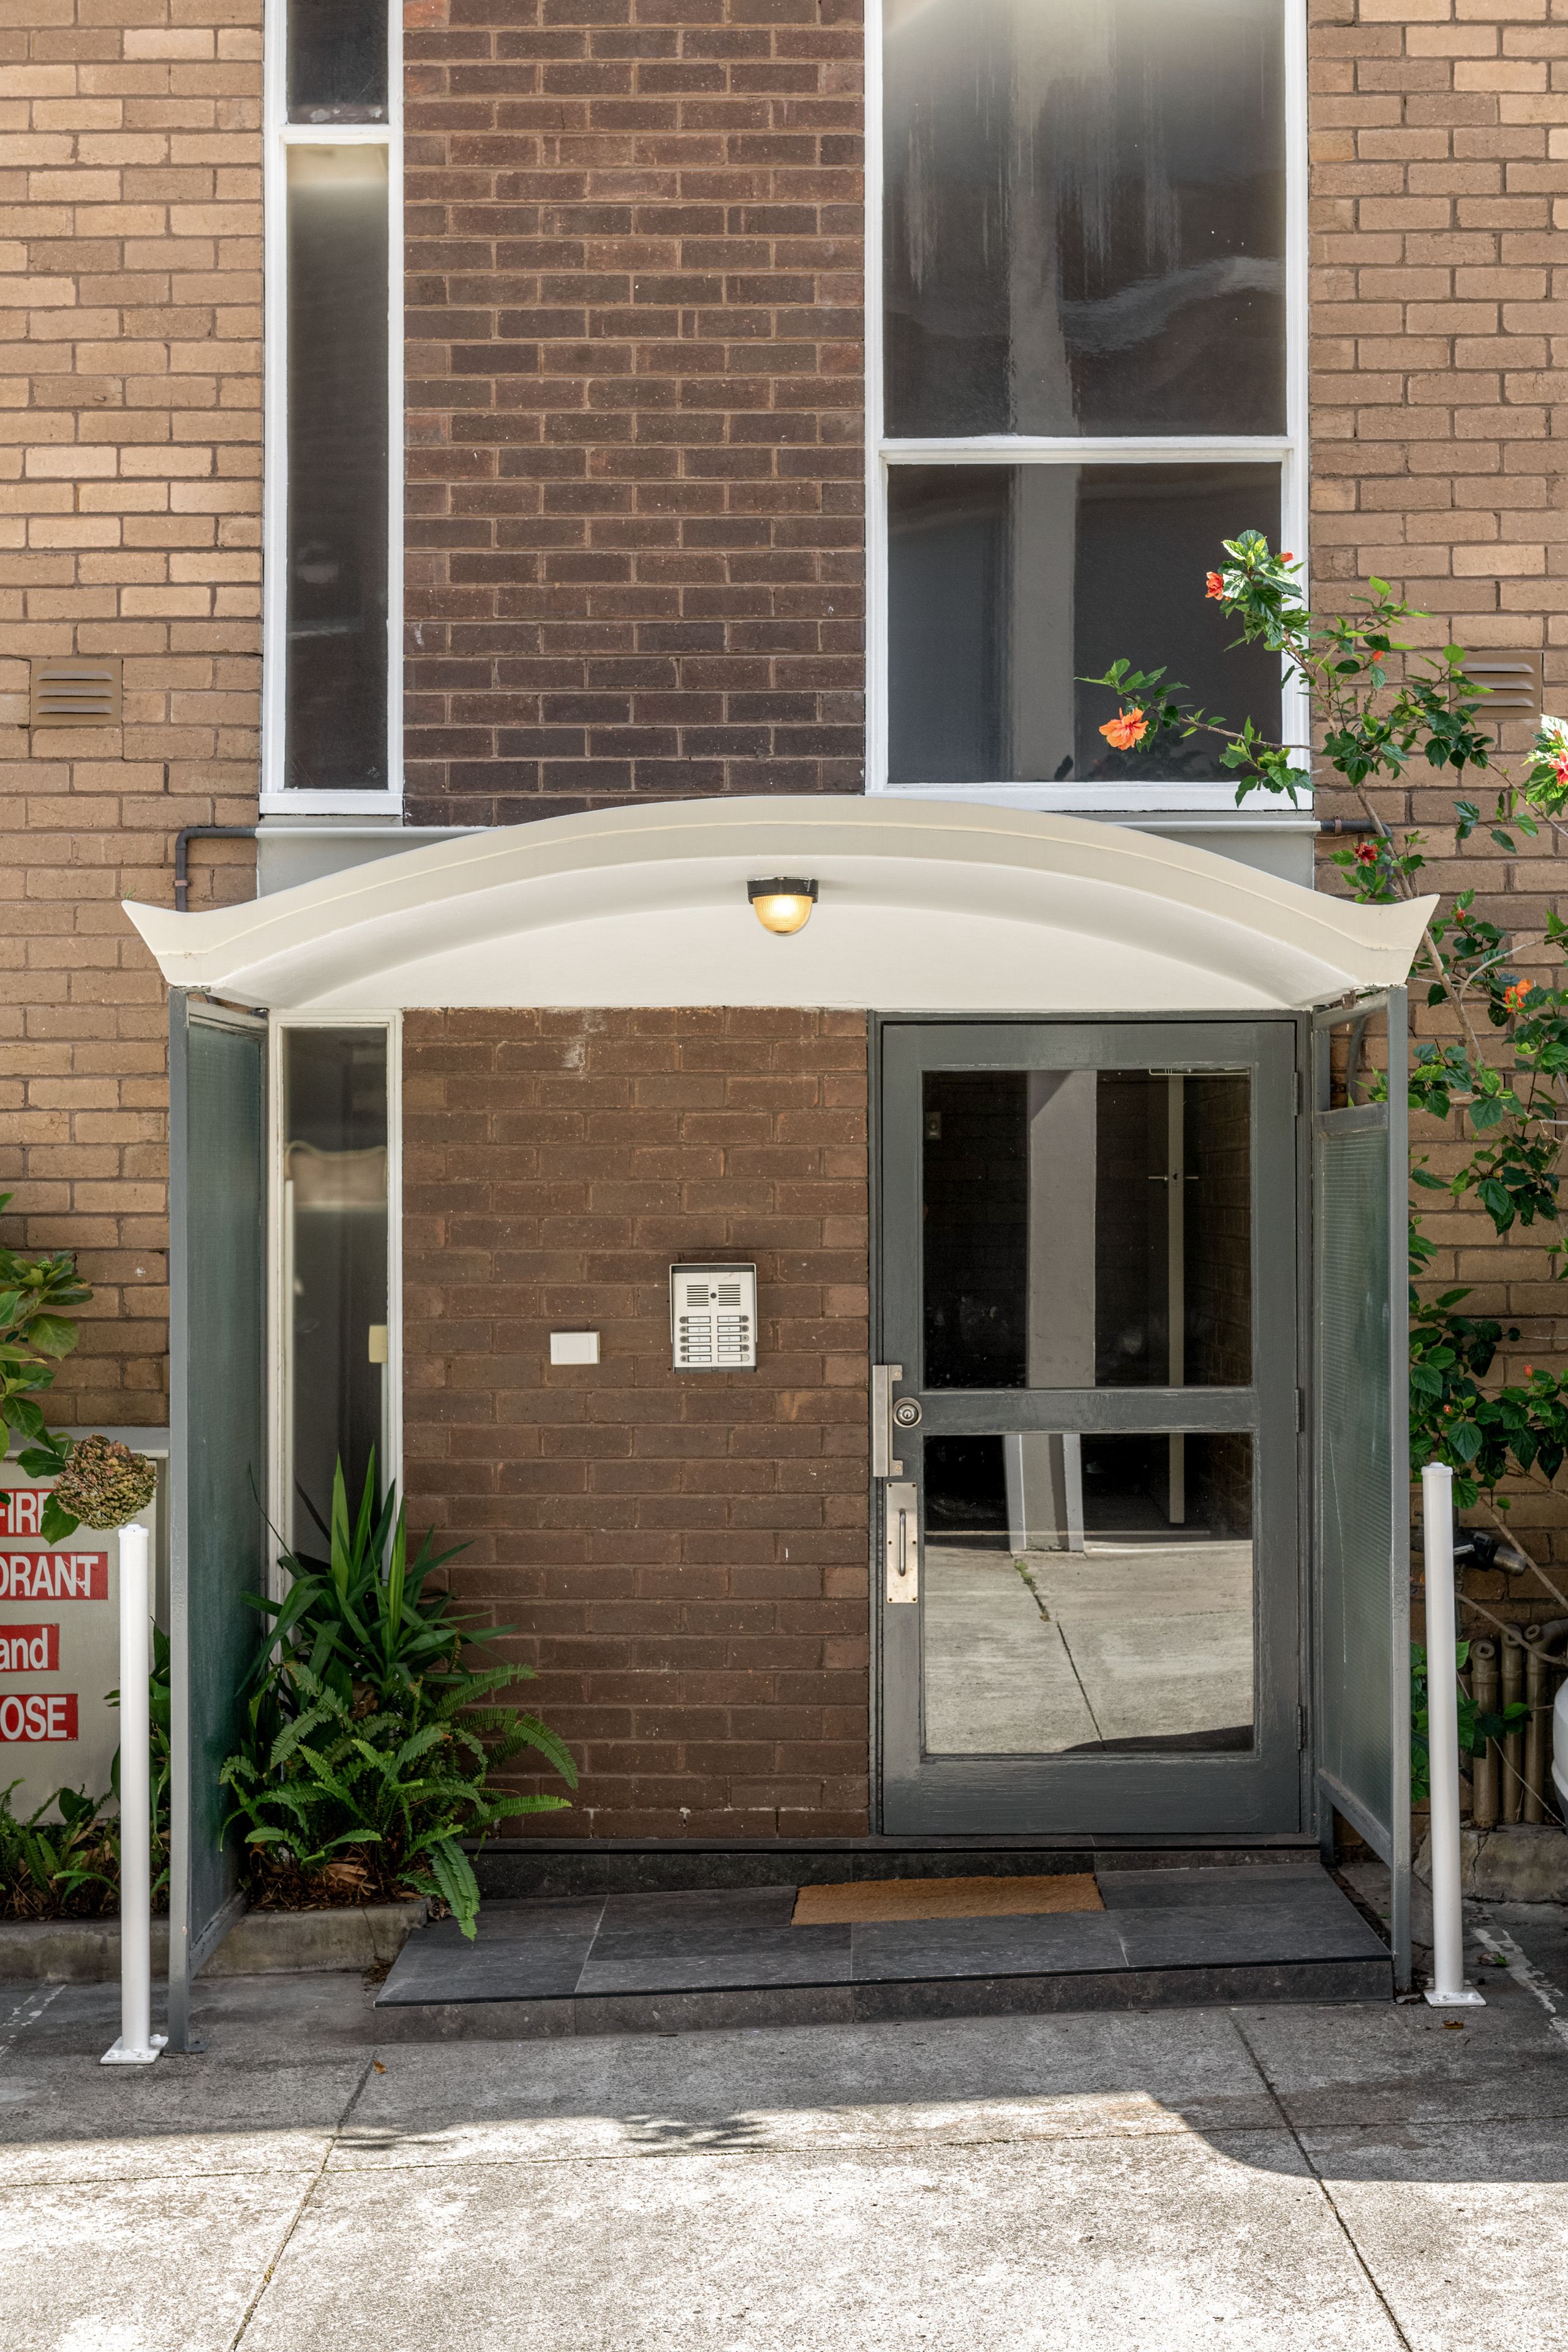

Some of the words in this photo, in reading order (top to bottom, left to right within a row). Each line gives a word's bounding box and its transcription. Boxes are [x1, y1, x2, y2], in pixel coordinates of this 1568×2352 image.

[0, 1492, 51, 1533] IR
[0, 1627, 48, 1670] and
[0, 1696, 67, 1740] OSE
